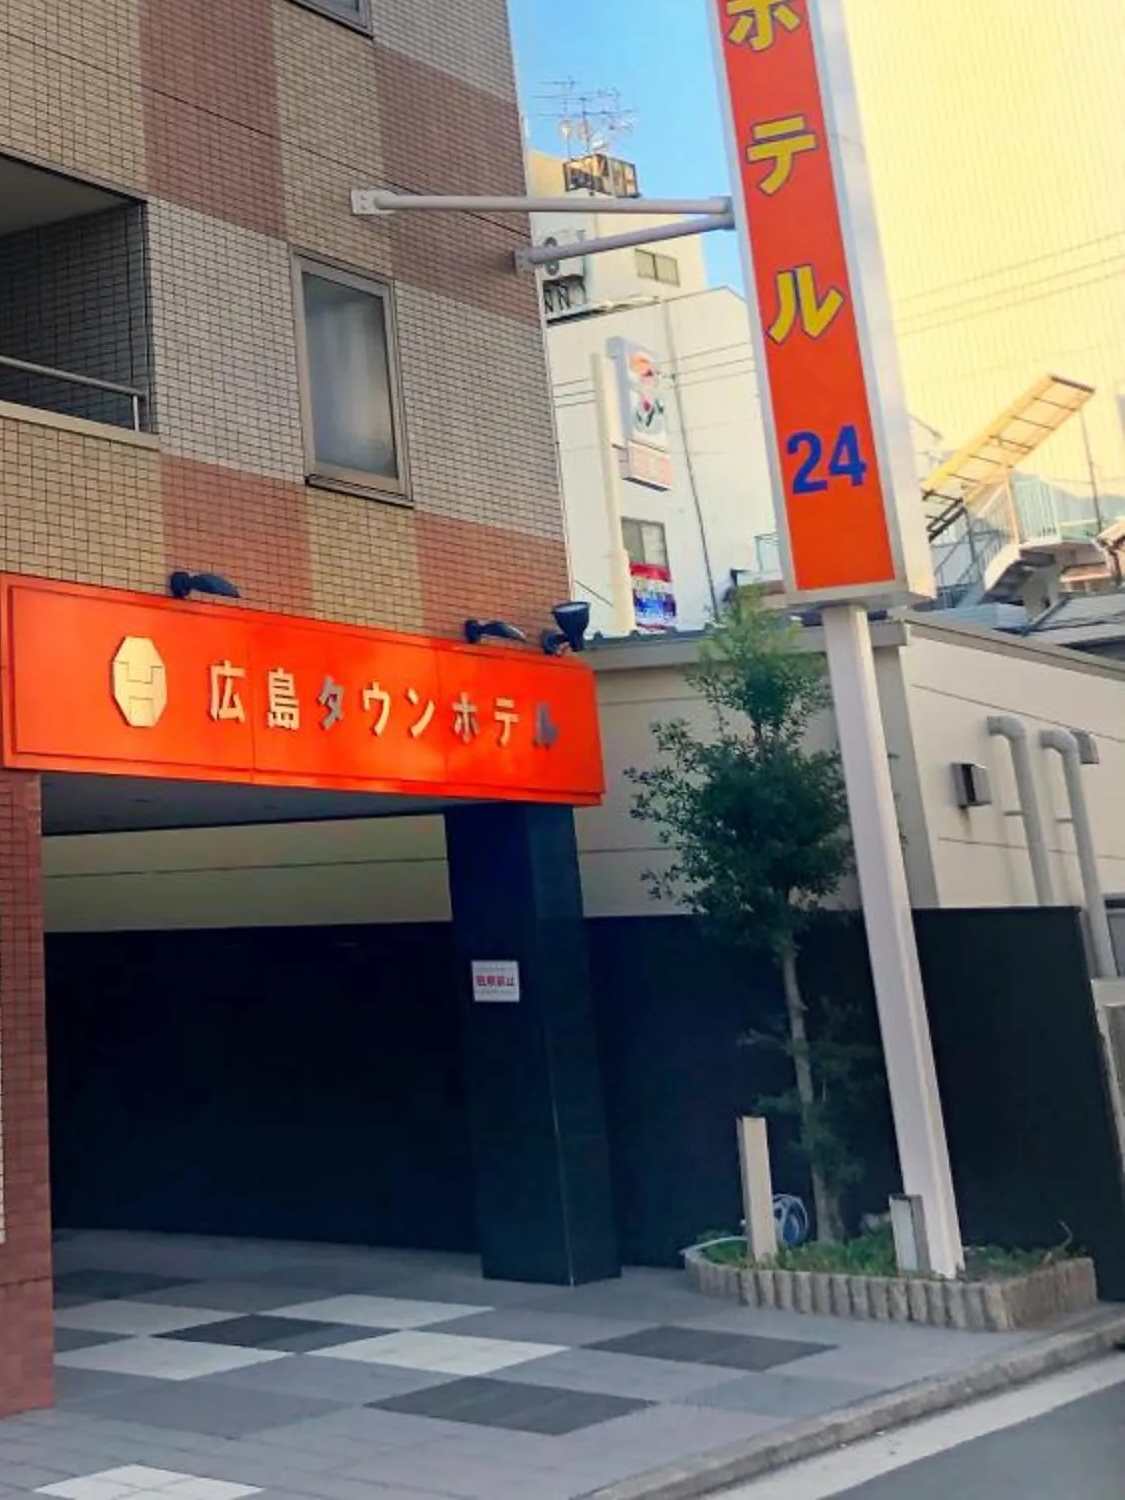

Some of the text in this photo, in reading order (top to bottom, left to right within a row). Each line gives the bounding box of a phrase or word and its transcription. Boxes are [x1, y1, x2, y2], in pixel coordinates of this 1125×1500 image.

[786, 425, 869, 496] 24
[208, 659, 557, 747] 広島タウンホテル
